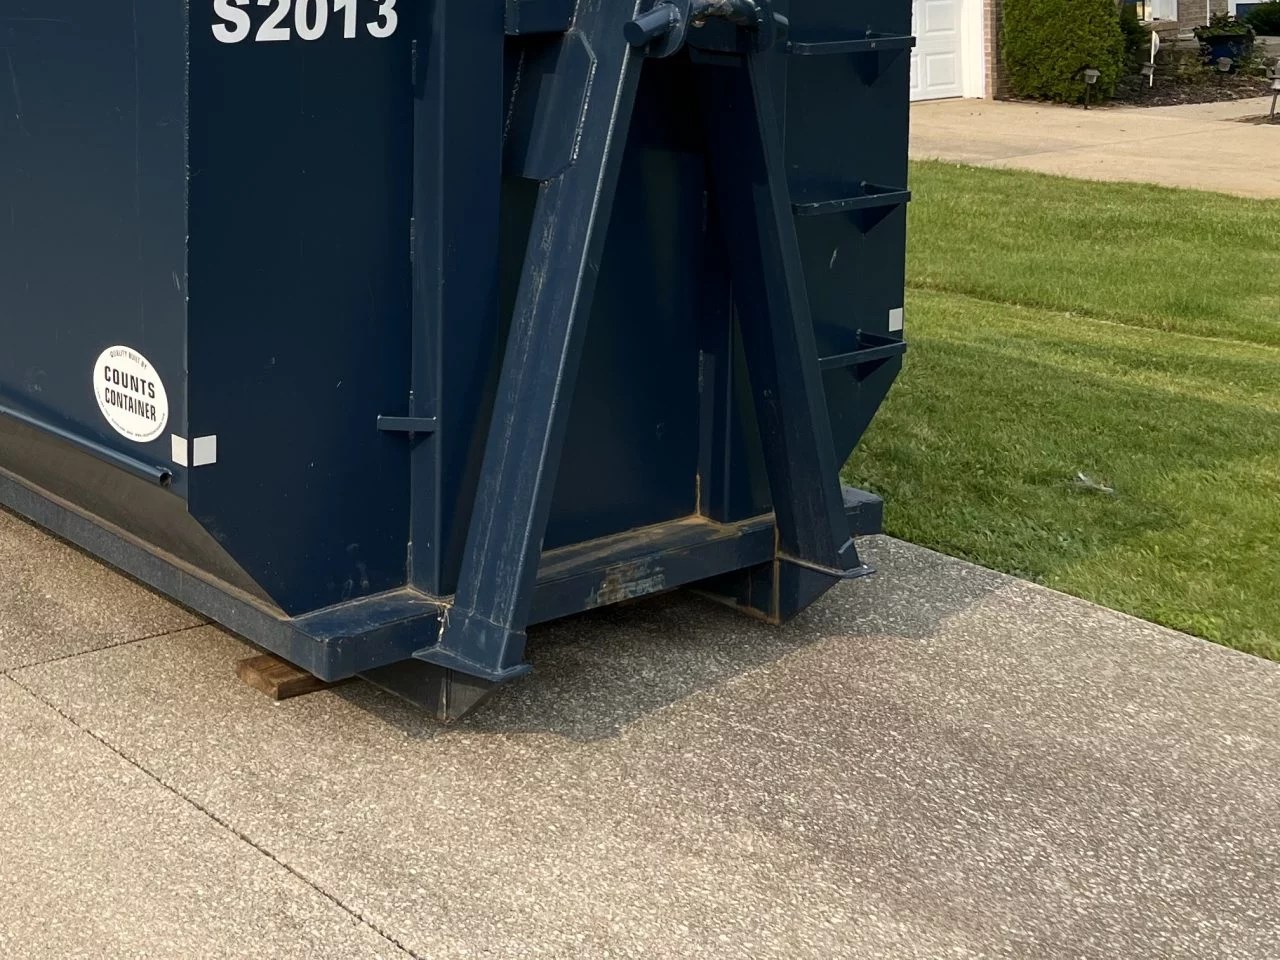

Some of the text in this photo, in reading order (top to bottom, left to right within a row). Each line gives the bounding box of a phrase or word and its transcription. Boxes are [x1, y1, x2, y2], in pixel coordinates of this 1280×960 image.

[109, 349, 128, 358] QUALITY
[128, 351, 141, 364] BUILT
[104, 365, 155, 399] COUNTS
[104, 387, 157, 422] CONTAINER
